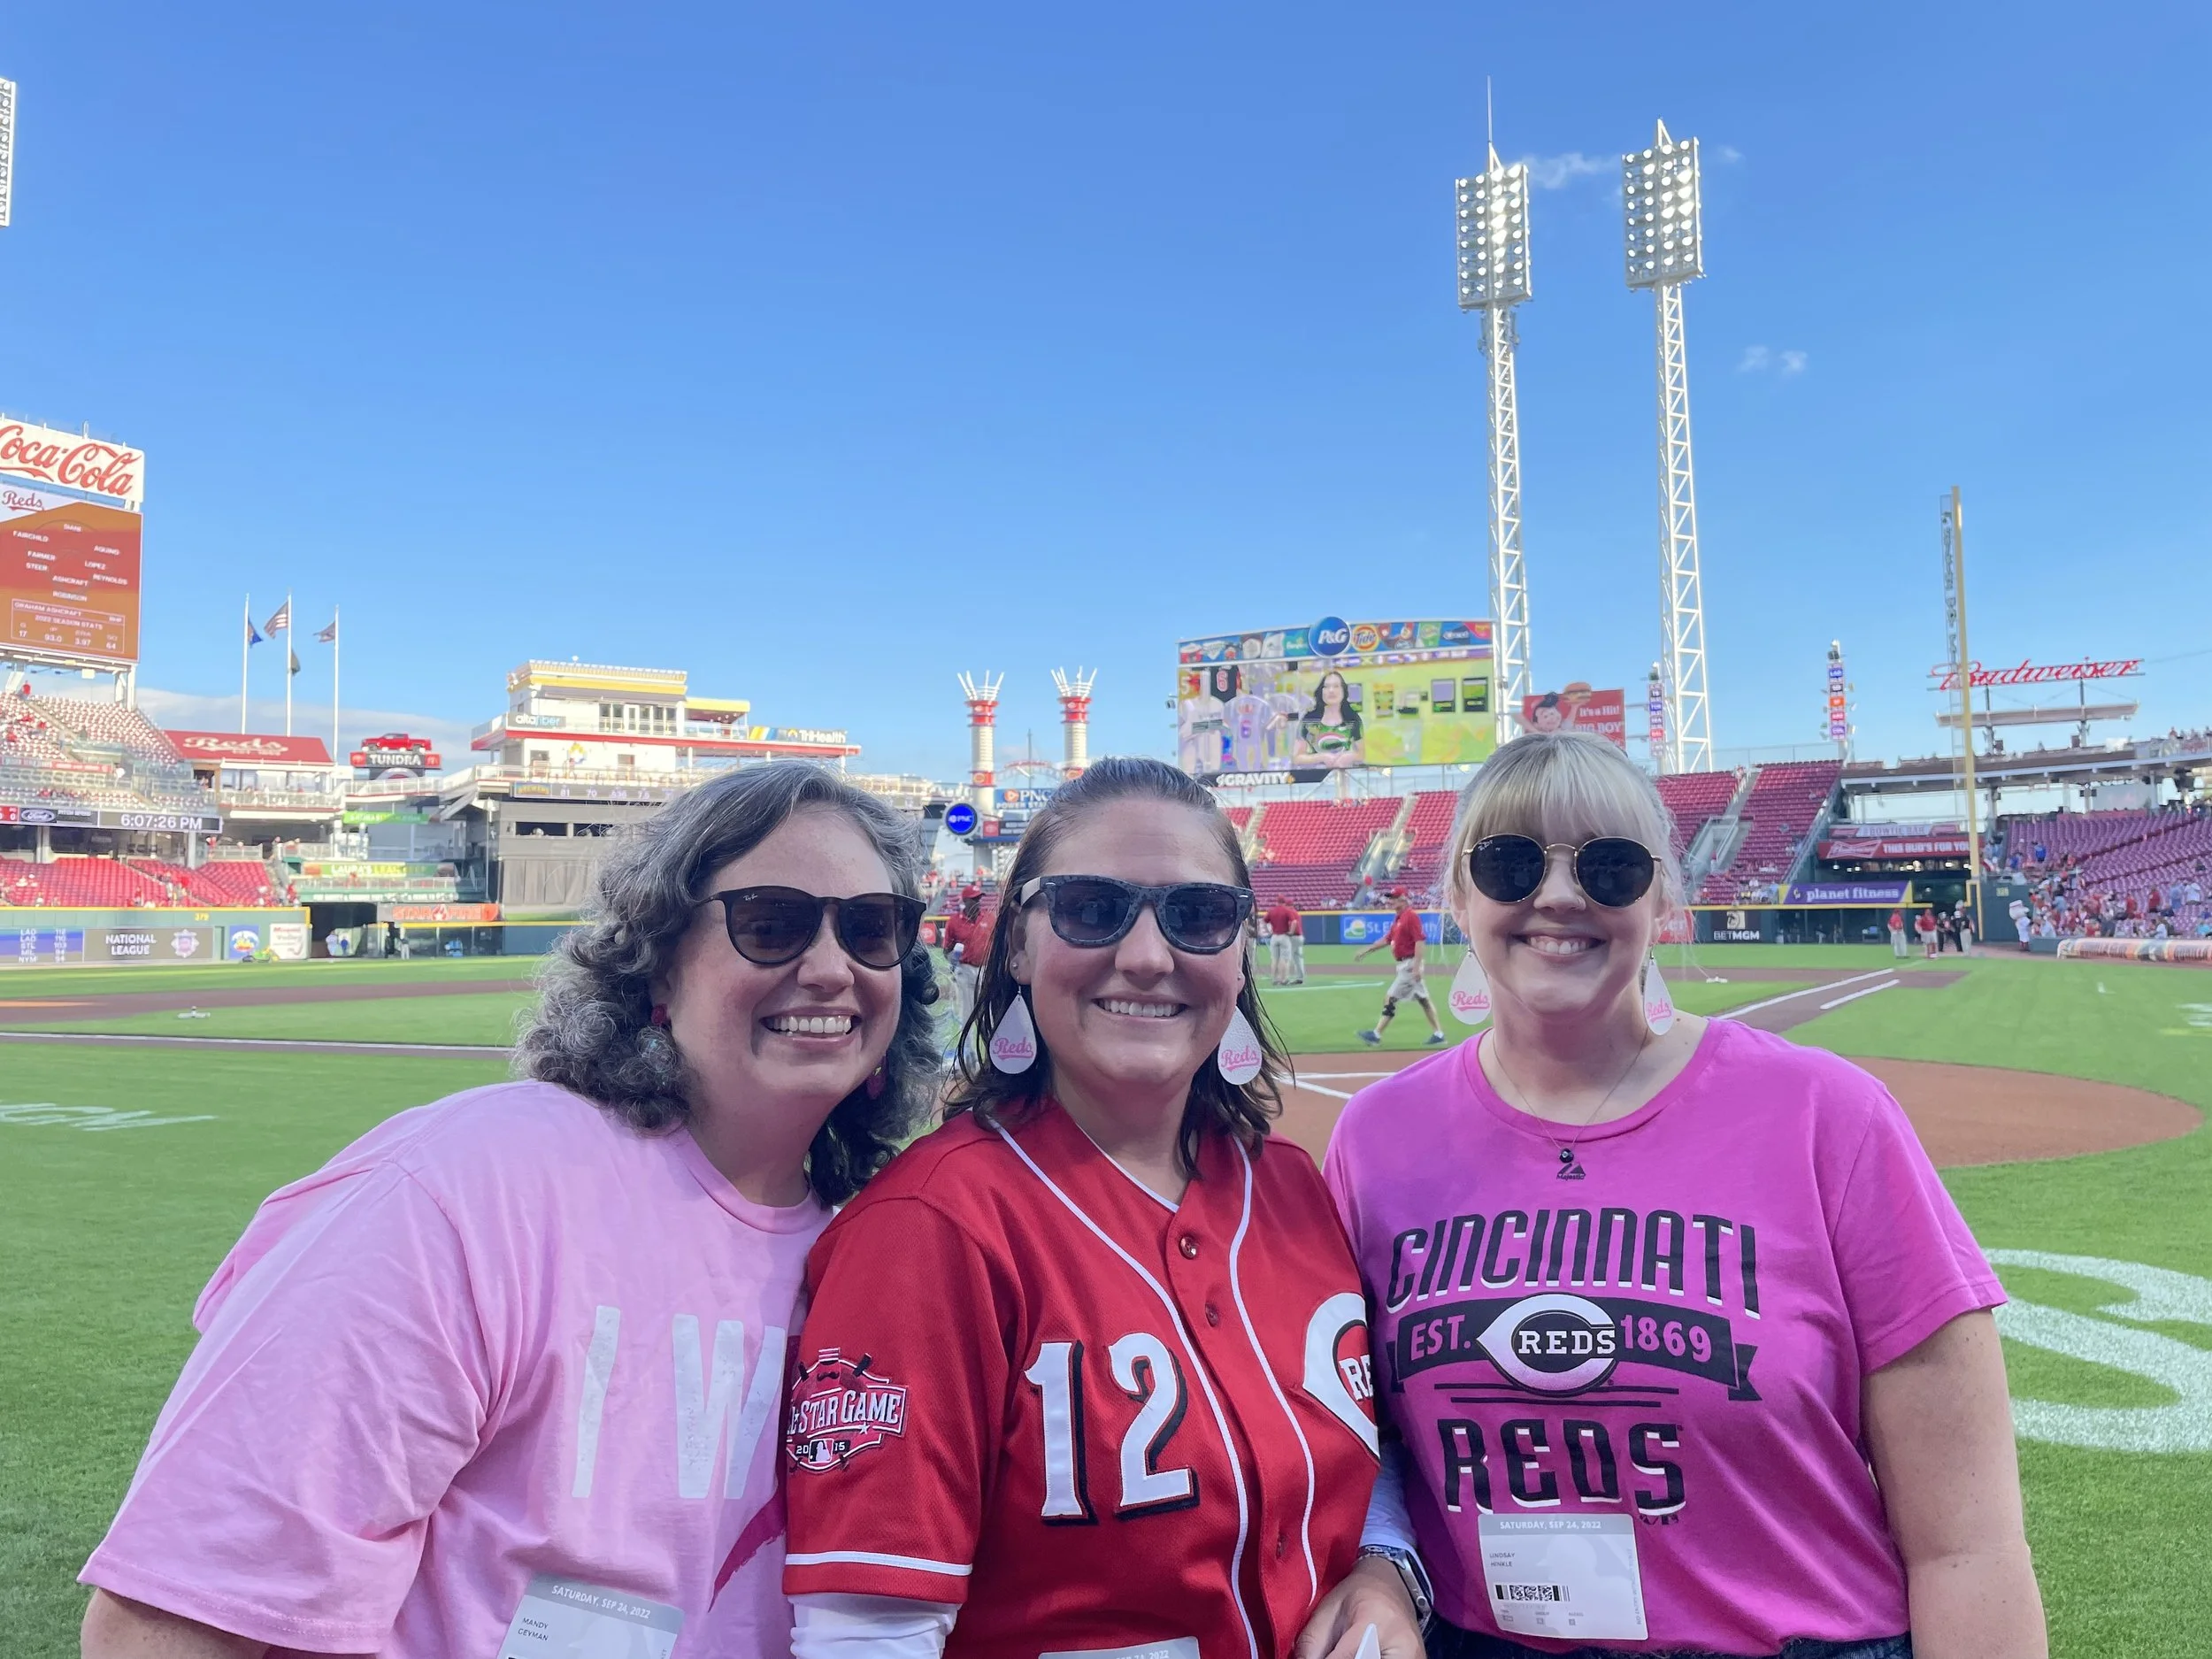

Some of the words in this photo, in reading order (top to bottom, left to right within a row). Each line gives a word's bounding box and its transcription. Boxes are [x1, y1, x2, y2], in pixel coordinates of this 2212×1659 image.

[2, 490, 44, 511] Reds
[13, 530, 49, 542] FAIRCHILD
[27, 550, 56, 561] FARMER
[26, 563, 48, 572] STEER
[84, 560, 106, 570] LOPEZ
[52, 575, 88, 587] ASHCRAFT
[93, 573, 127, 585] REYNOLDS
[46, 606, 81, 617] ASHCRAFT
[1318, 627, 1348, 644] P&G
[1931, 657, 2139, 690] Budweiser
[1597, 721, 1621, 733] BOY
[183, 736, 288, 752] Reds
[799, 730, 846, 743] TriHealth
[369, 754, 421, 765] TUNDRA
[120, 814, 176, 829] 6:07:26
[180, 817, 203, 830] PM
[1883, 843, 1901, 854] THIS
[1934, 841, 1952, 852] FOR
[1807, 887, 1847, 902] planet
[1851, 887, 1899, 899] fitness
[105, 934, 157, 944] NATIONAL
[1714, 930, 1760, 941] BETMGM
[111, 945, 150, 956] LEAGUE
[1451, 990, 1491, 1010] Reds
[1646, 997, 1672, 1023] Reds
[994, 1037, 1033, 1060] Reds
[1221, 1049, 1261, 1071] Reds
[1386, 1208, 1761, 1320] CINCINNATI
[1410, 1315, 1471, 1361] EST.
[1621, 1315, 1712, 1363] 1869
[1517, 1330, 1617, 1355] REDS
[572, 1305, 621, 1498] I
[841, 1389, 901, 1424] GAME
[1024, 1332, 1201, 1526] 12
[1438, 1419, 1686, 1516] REDS
[1500, 1521, 1548, 1531] SATURDAY,
[1567, 1521, 1579, 1530] 24,
[551, 1585, 599, 1608] SATURDAY,
[601, 1598, 617, 1609] SEP
[618, 1602, 629, 1616] 24,
[630, 1606, 651, 1619] 2022
[522, 1617, 549, 1630] MANDY
[518, 1628, 549, 1641] GEYMAN
